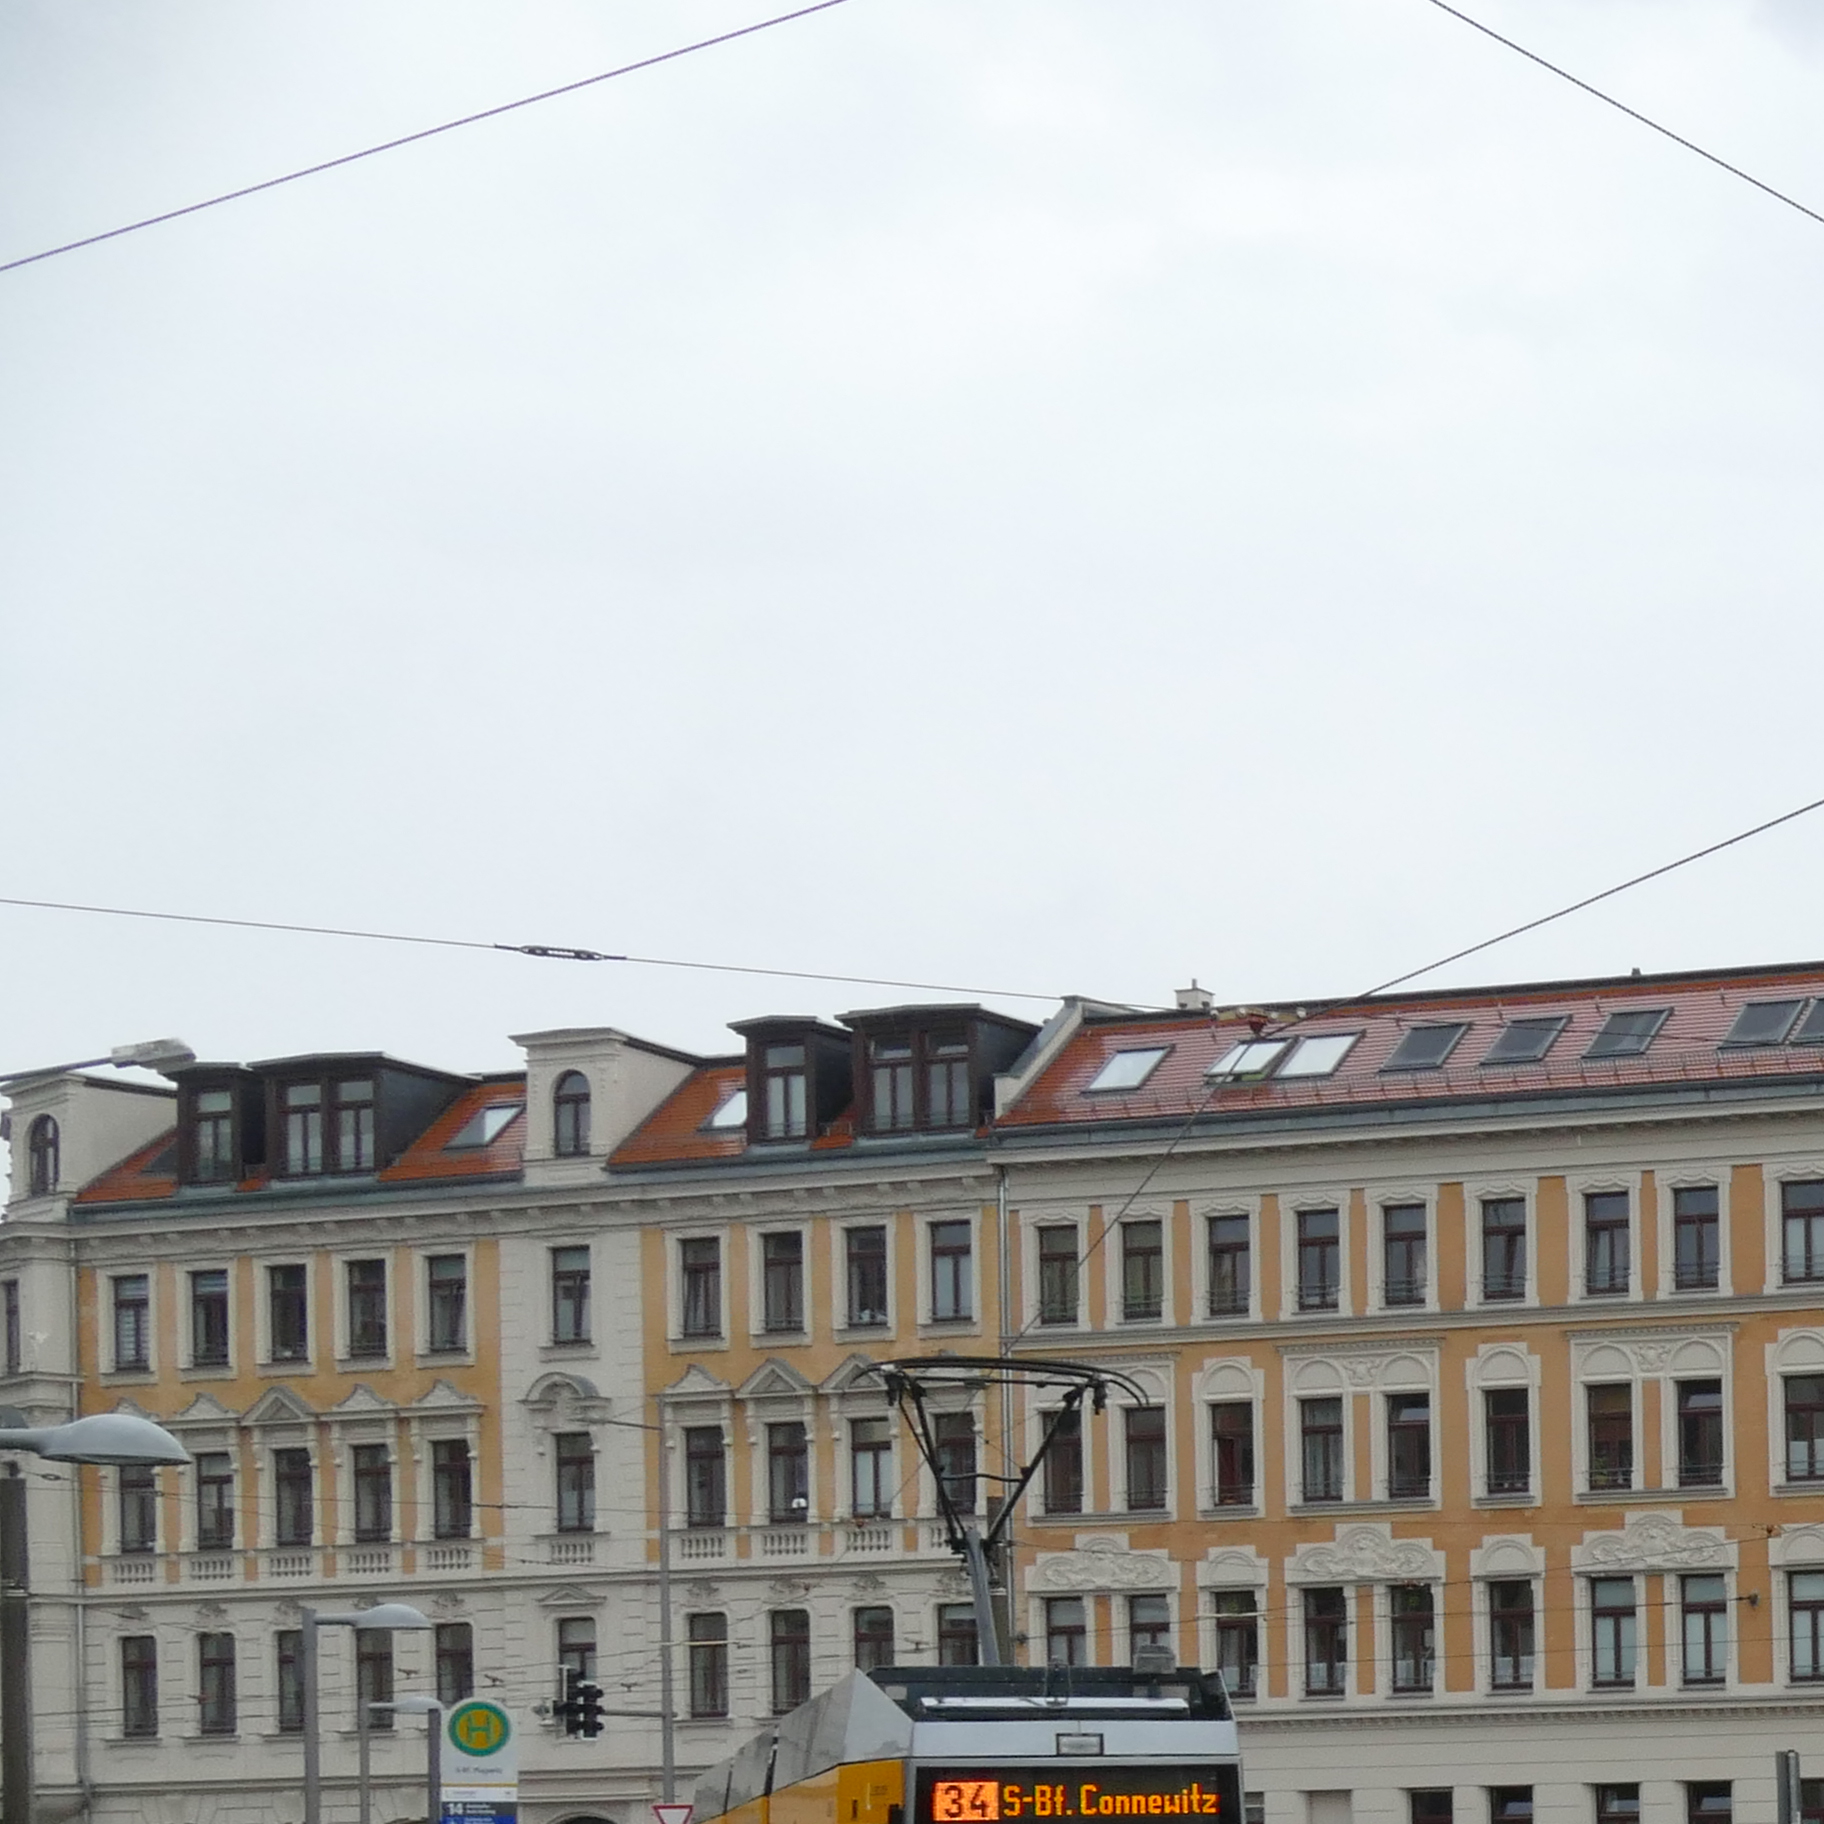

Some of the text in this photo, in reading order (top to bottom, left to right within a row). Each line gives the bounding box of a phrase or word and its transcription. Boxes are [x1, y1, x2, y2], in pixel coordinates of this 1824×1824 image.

[448, 1803, 463, 1815] 14
[944, 1782, 1219, 1818] 34 S-Bf. Connewitz
